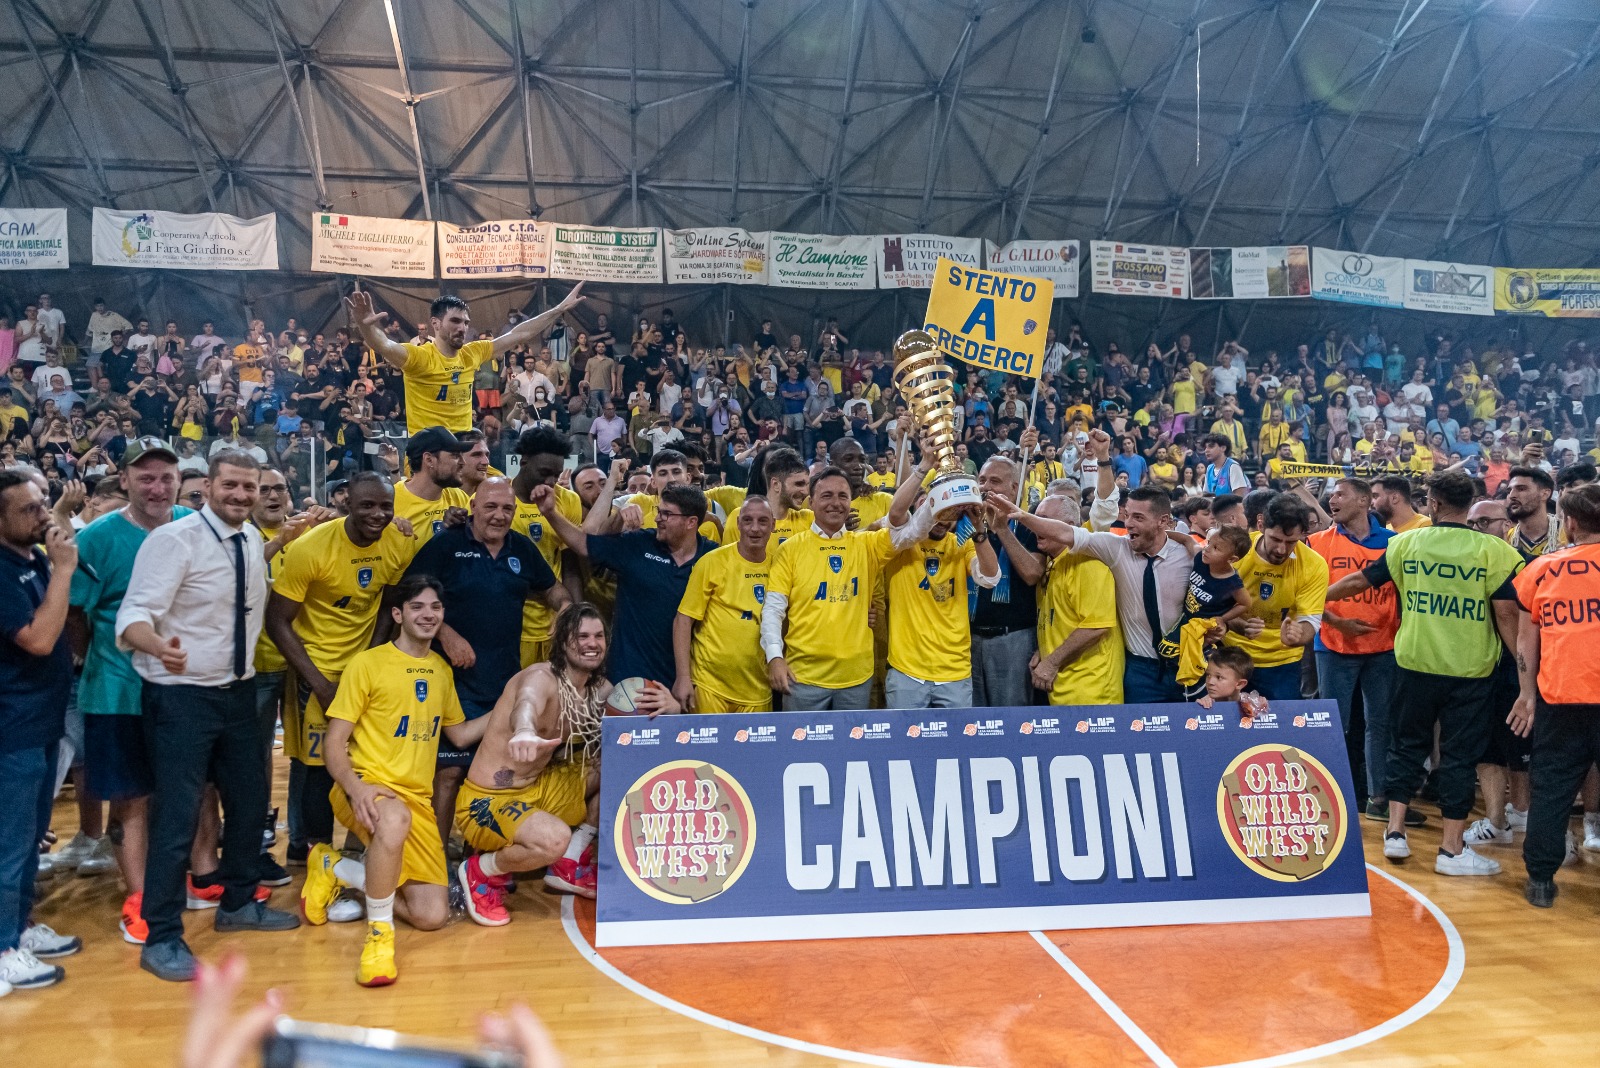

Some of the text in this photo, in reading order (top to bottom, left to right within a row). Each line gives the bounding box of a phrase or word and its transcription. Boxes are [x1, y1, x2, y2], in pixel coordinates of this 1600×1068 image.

[458, 223, 538, 234] STUDIO C.T.A.
[153, 229, 236, 242] Cooperativa Agricola
[319, 229, 356, 241] MICHELE
[358, 232, 414, 245] TAGLIAFIERRO
[446, 234, 484, 243] CONSULENZA
[488, 233, 512, 243] TECNICA
[558, 230, 655, 246] IDROTHERMO SYSTEM
[17, 239, 62, 250] AMBIENTALE
[686, 232, 765, 252] Online System
[906, 239, 953, 250] ISTITUTO
[137, 242, 151, 253] La
[155, 242, 179, 253] Fara
[183, 242, 234, 255] Giardino
[456, 244, 497, 252] VALUTAZIONI
[446, 251, 496, 259] PROGETTAZIONI
[555, 250, 590, 259] PROGETTAZIONE
[592, 252, 626, 262] INSTALLAZIONE
[693, 249, 727, 258] HARDWARE
[734, 250, 766, 262] SOFTWARE
[796, 247, 868, 270] Campione
[907, 250, 917, 259] DI
[1115, 262, 1165, 273] ROSSANO
[778, 269, 824, 278] Specialista
[949, 266, 1036, 303] STENTO
[1363, 292, 1390, 300] telecom
[961, 298, 996, 342] A
[925, 323, 1034, 375] CREDERCI
[1284, 465, 1306, 475] ASKET
[351, 556, 382, 565] GIVOVA
[645, 552, 671, 564] GIVOVA
[1332, 557, 1376, 570] GIV
[1254, 571, 1283, 579] GIVOVA
[1403, 560, 1487, 582] GIVOVA
[814, 577, 859, 601] A 1
[1190, 584, 1213, 603] REVER
[1407, 590, 1486, 622] STEWARD
[1089, 717, 1114, 726] LNP
[1143, 716, 1169, 725] LNP
[1198, 715, 1223, 723] LNP
[1305, 712, 1329, 721] LNP
[394, 715, 441, 738] A 1
[864, 723, 890, 732] LNP
[921, 722, 947, 731] LNP
[977, 720, 1003, 729] LNP
[1034, 719, 1059, 727] LNP
[633, 729, 660, 738] LNP
[691, 728, 718, 737] LNP
[749, 726, 776, 735] LNP
[807, 725, 833, 733] LNP
[1244, 762, 1308, 794] OLD
[650, 779, 719, 812] OLD
[1238, 793, 1322, 827] WILD
[783, 752, 1194, 891] CAMPIONI
[641, 811, 729, 846] WILD
[1238, 824, 1329, 859] WEST
[635, 844, 734, 879] WEST
